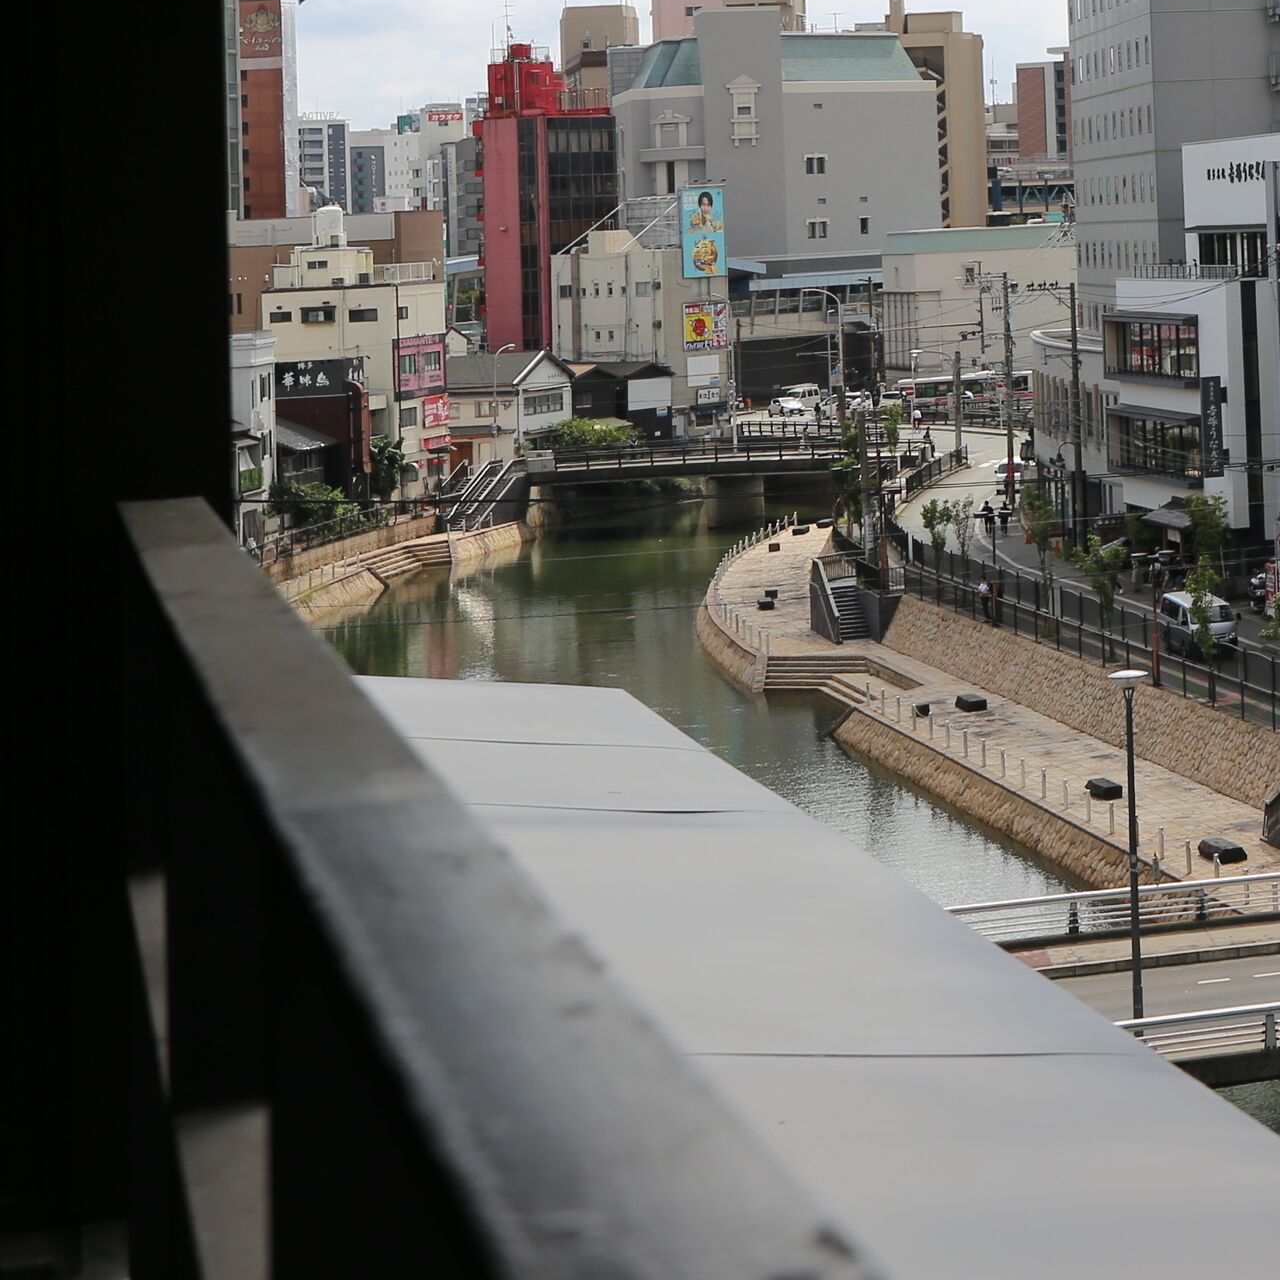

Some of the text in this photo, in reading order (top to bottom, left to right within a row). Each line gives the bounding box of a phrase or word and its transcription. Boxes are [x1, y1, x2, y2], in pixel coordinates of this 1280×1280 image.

[431, 113, 461, 121] カラオケ
[282, 371, 330, 391] 華味鳥
